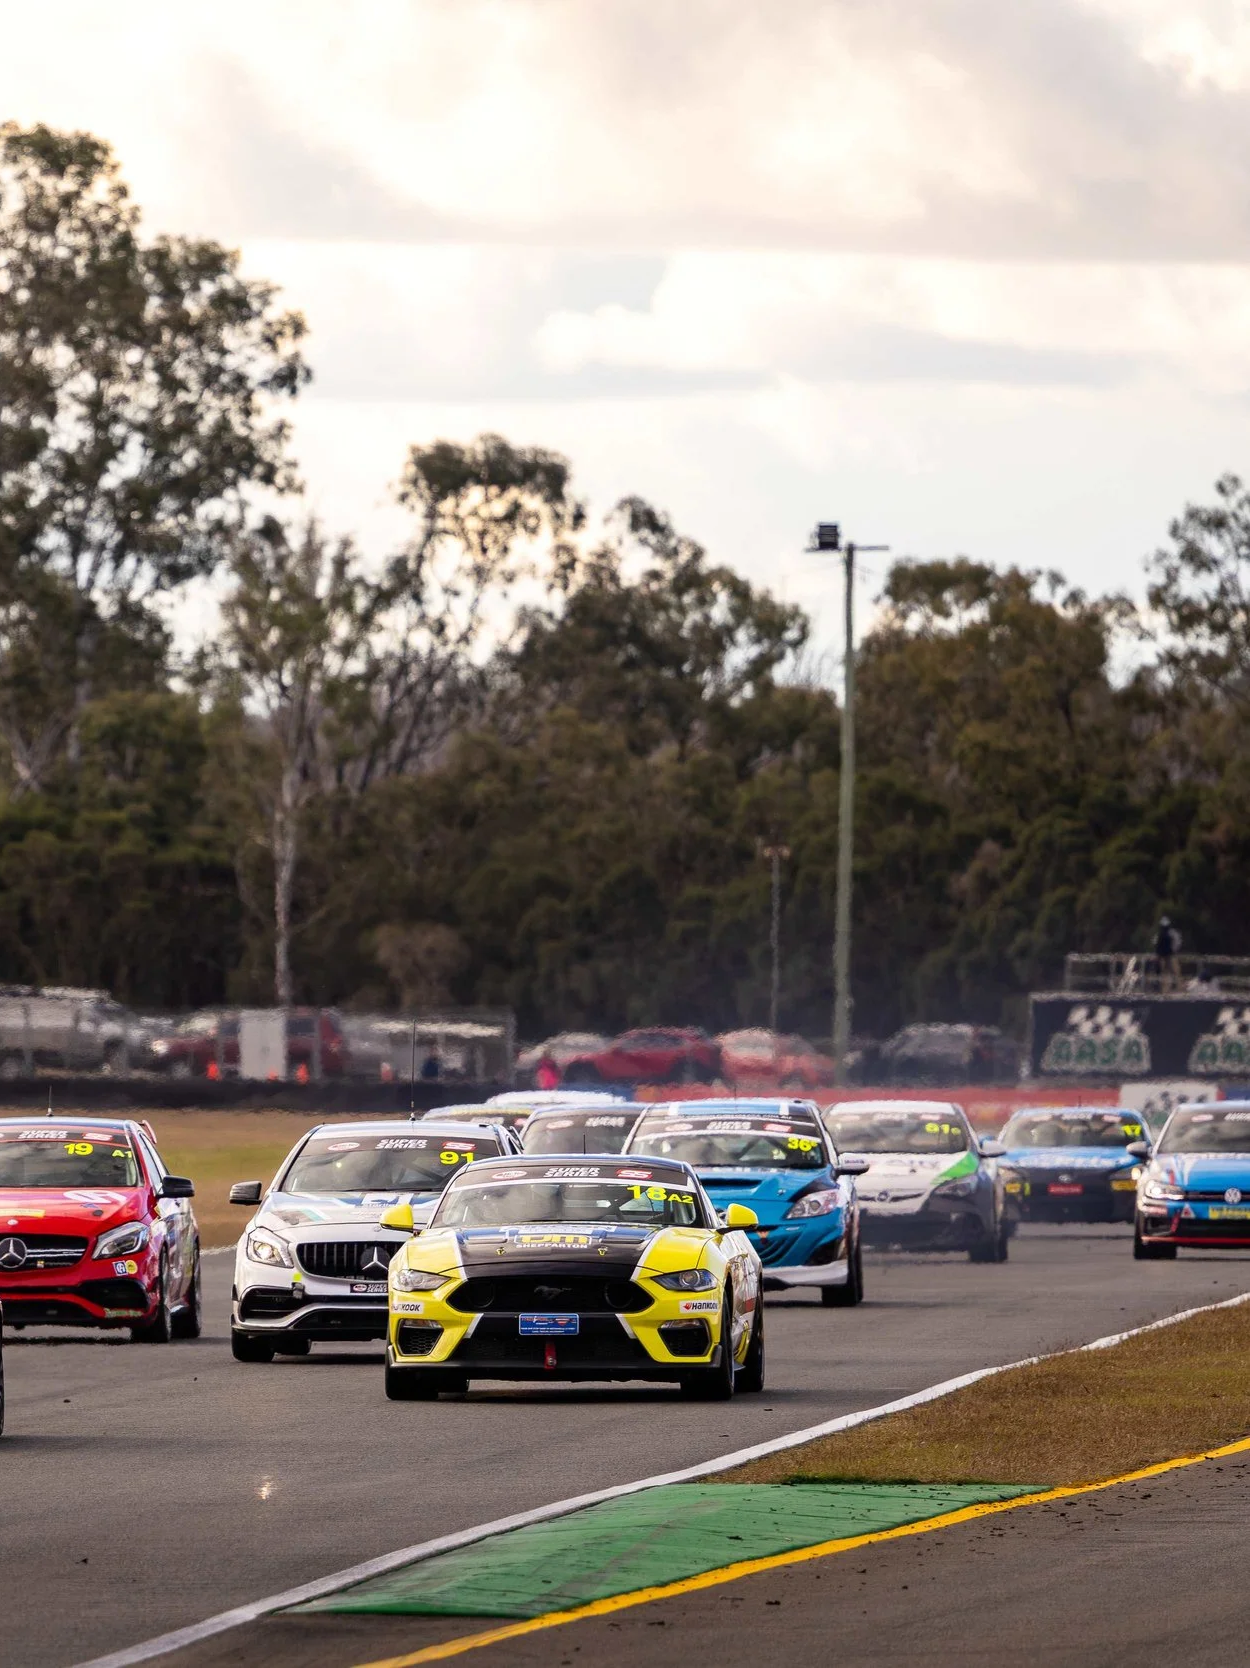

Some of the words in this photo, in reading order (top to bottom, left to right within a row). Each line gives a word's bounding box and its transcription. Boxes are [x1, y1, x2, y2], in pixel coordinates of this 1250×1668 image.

[64, 1143, 94, 1156] 19
[111, 1149, 133, 1159] A1
[439, 1151, 474, 1165] 91
[626, 1185, 667, 1201] 18
[667, 1192, 694, 1204] A2
